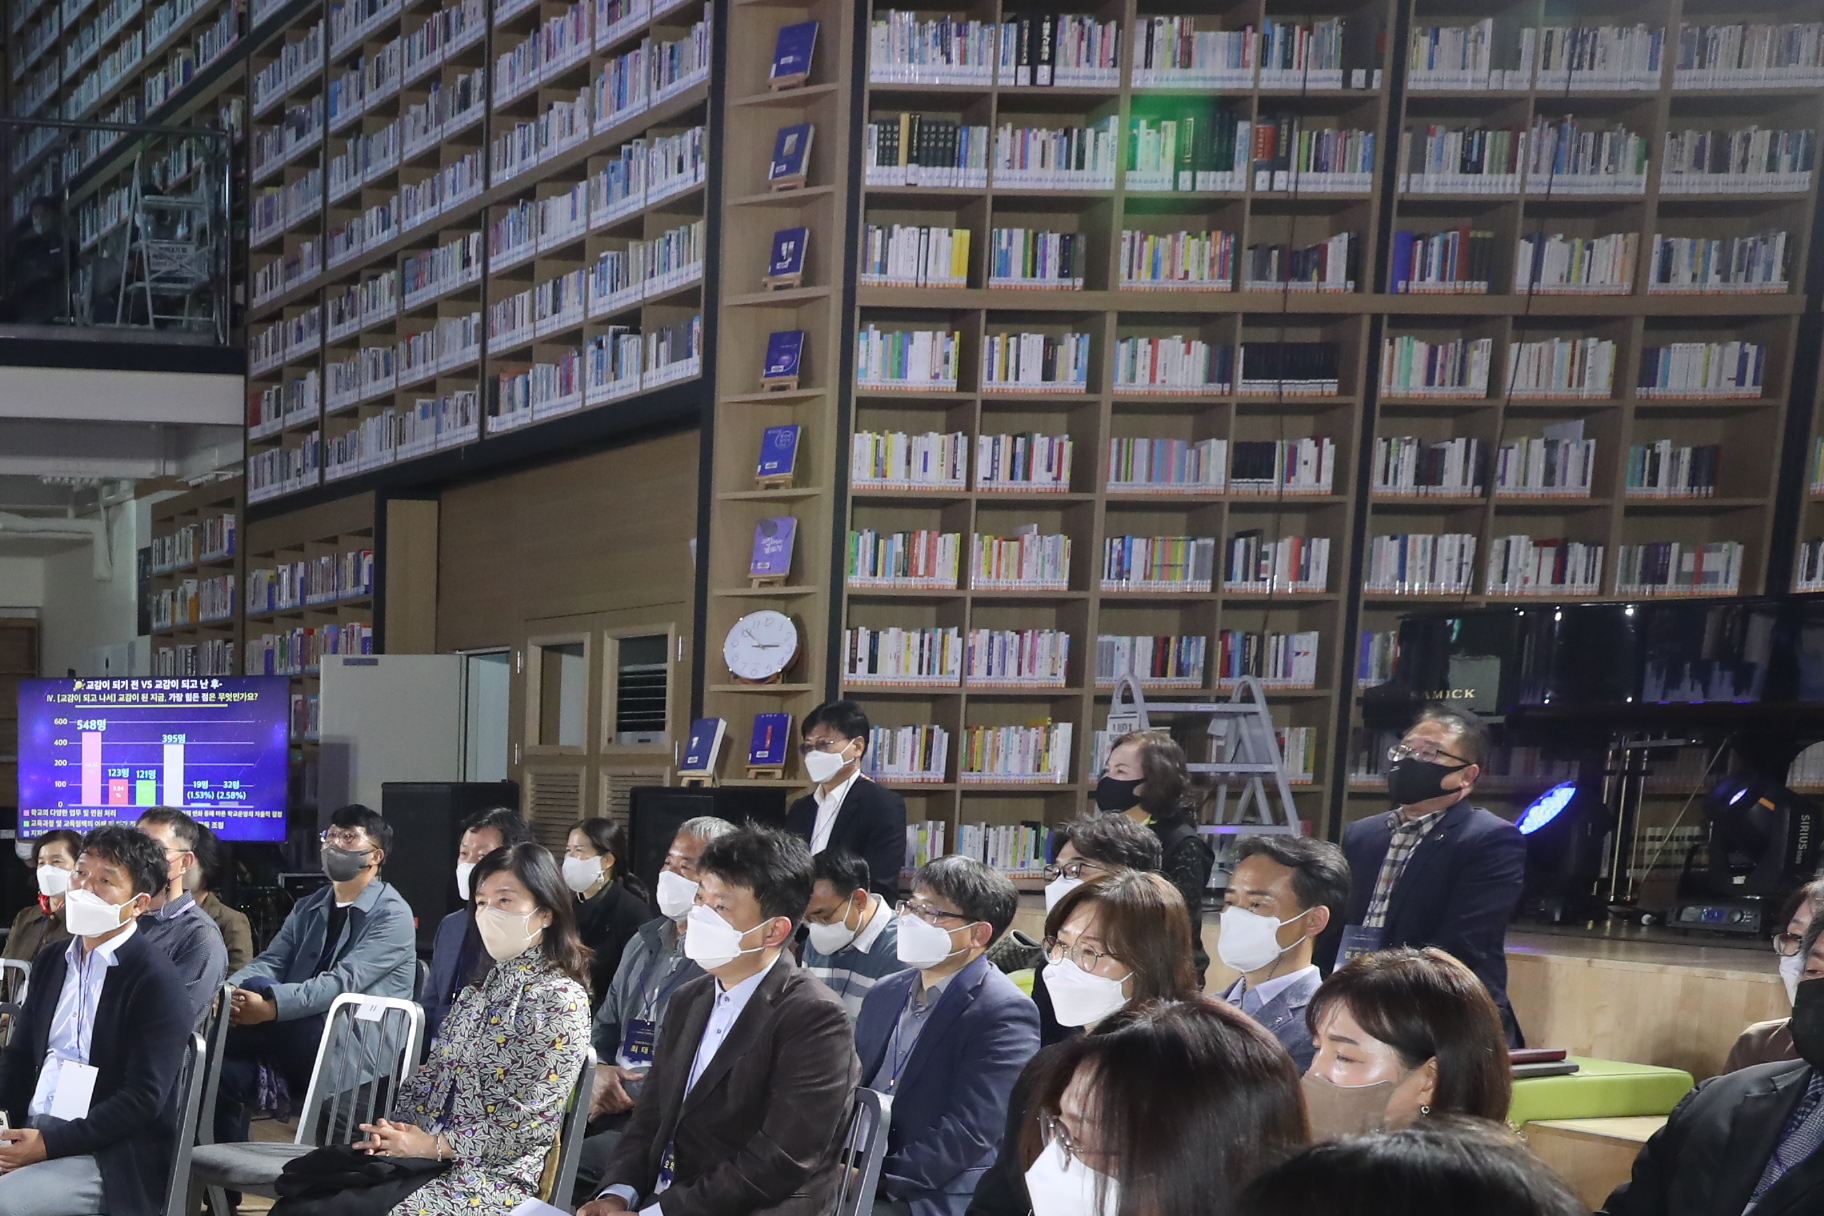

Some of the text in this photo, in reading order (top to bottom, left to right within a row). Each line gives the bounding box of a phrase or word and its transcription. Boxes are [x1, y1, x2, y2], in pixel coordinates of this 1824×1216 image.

[86, 679, 110, 691] 교감이
[112, 679, 129, 691] 되기
[130, 679, 139, 691] 전
[141, 679, 153, 691] VS
[154, 679, 179, 691] 교감이
[181, 679, 198, 691] 되고
[200, 679, 209, 691] 난
[83, 692, 98, 703] 되고
[98, 692, 117, 703] 나서]
[118, 692, 140, 703] 교감이
[168, 692, 183, 703] 가장
[185, 692, 200, 703] 힘든
[201, 692, 216, 703] 점은
[217, 692, 259, 703] 무엇인가요?
[1409, 688, 1476, 700] SAMICK
[53, 717, 68, 726] 600
[76, 718, 107, 732] 548명
[53, 738, 68, 747] 400
[161, 733, 186, 745] 395명
[54, 759, 68, 767] 200
[108, 768, 130, 779] 123명
[135, 768, 157, 780] 121명
[54, 780, 67, 788] 100
[192, 779, 209, 790] 19명
[222, 779, 240, 790] 32명
[187, 790, 215, 801] (1.53%)
[216, 790, 247, 801] (2.58%)
[1798, 814, 1811, 850] SIRIUS
